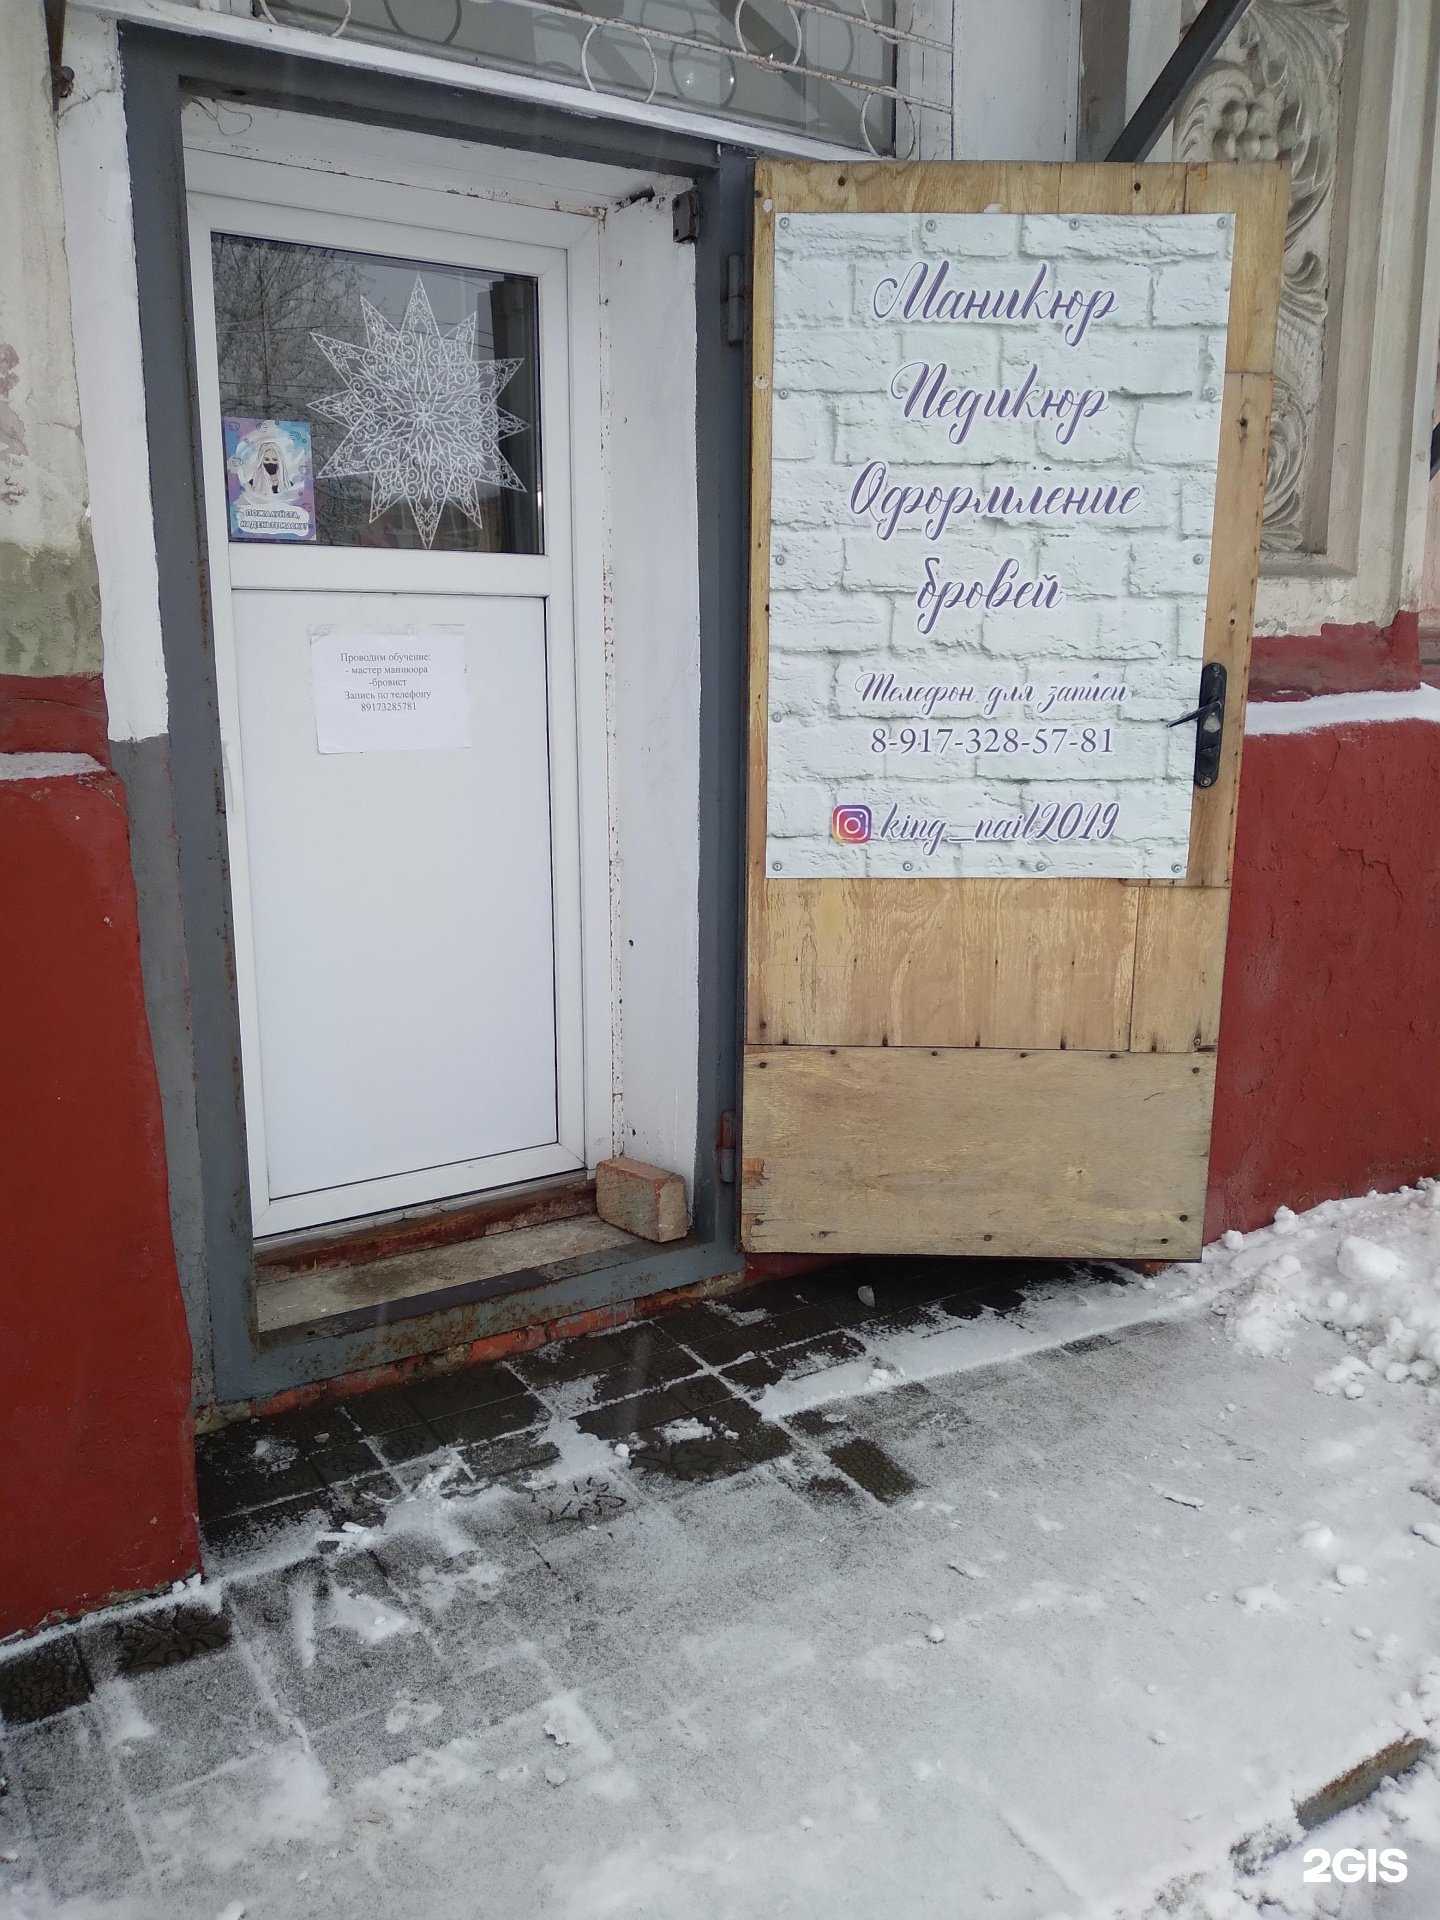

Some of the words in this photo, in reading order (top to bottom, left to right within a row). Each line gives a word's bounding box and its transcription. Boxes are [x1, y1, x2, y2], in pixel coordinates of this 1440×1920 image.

[873, 260, 1118, 347] Маникюр
[891, 361, 1108, 446] Педикюр
[850, 461, 1143, 541] Оформление
[916, 557, 1063, 635] бровей
[340, 653, 386, 663] Проводим
[388, 653, 431, 663] обучение:
[351, 667, 382, 676] мастер
[344, 690, 375, 700] Запись
[389, 689, 431, 701] телефону
[360, 702, 417, 712] 89173285781
[854, 673, 976, 716] Телефон
[983, 684, 1035, 716] для
[1037, 684, 1129, 714] записи
[871, 728, 1113, 754] 8-917-328-57-81
